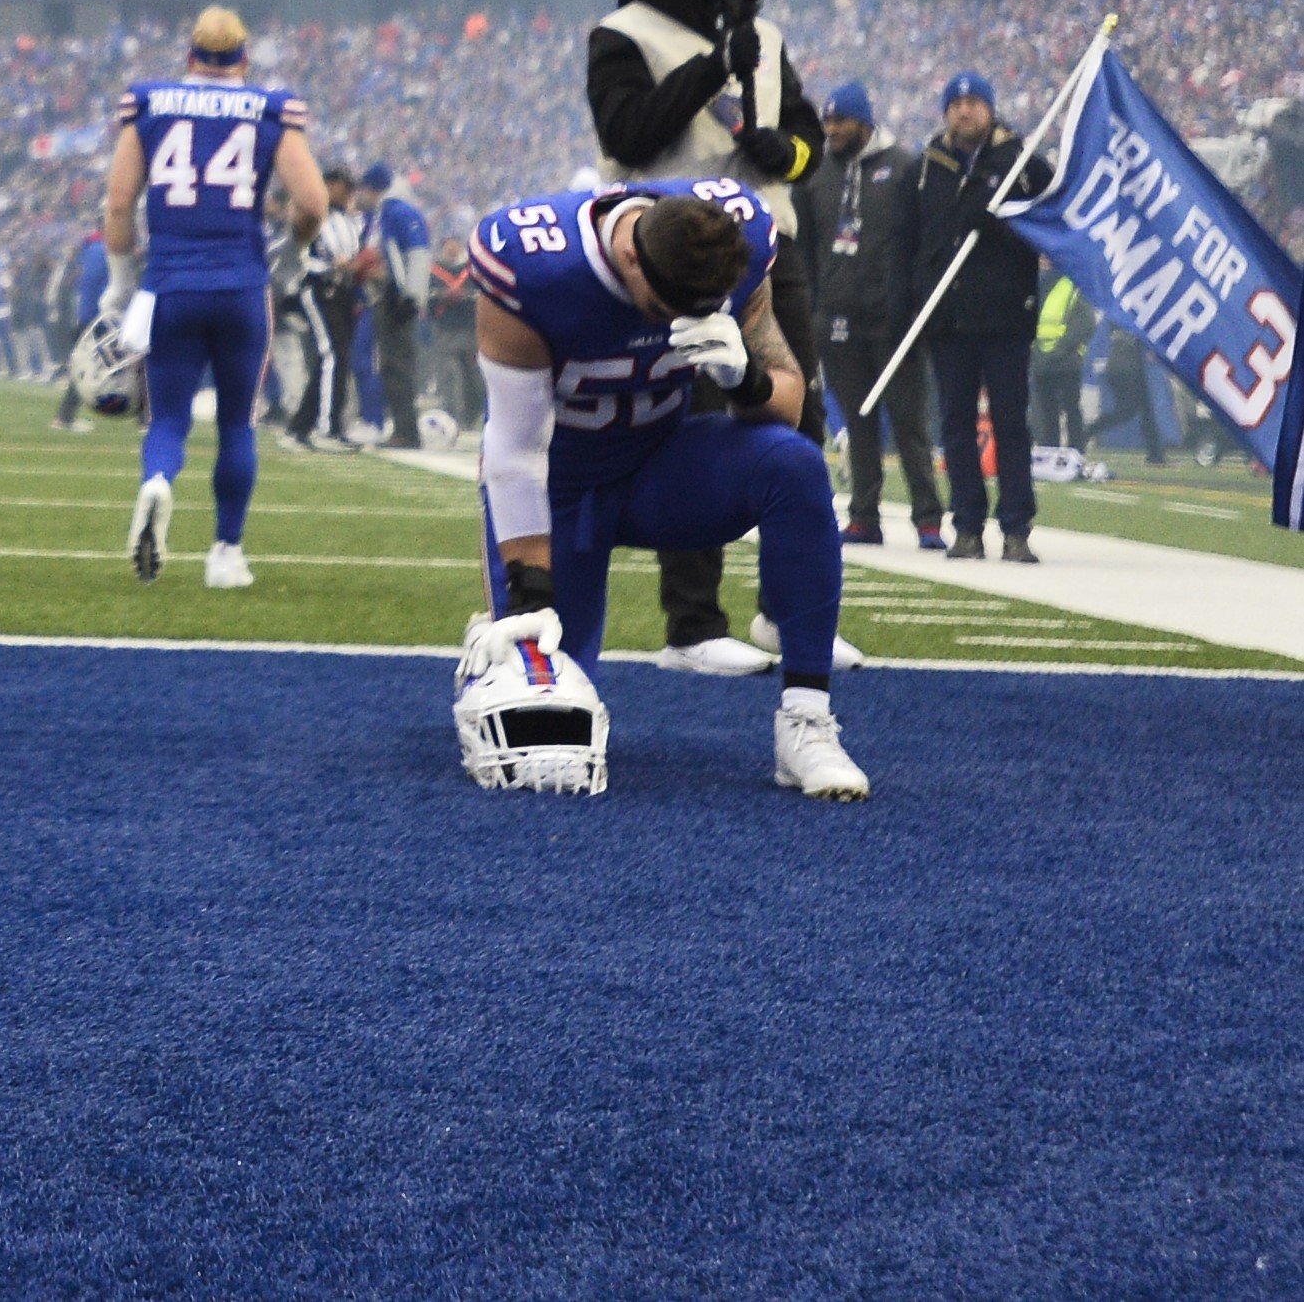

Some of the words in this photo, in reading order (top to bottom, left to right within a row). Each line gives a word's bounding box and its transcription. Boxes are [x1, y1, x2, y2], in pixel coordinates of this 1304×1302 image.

[149, 119, 259, 209] 44
[507, 203, 567, 254] 52
[1172, 204, 1249, 301] FOR
[1200, 288, 1297, 429] 3
